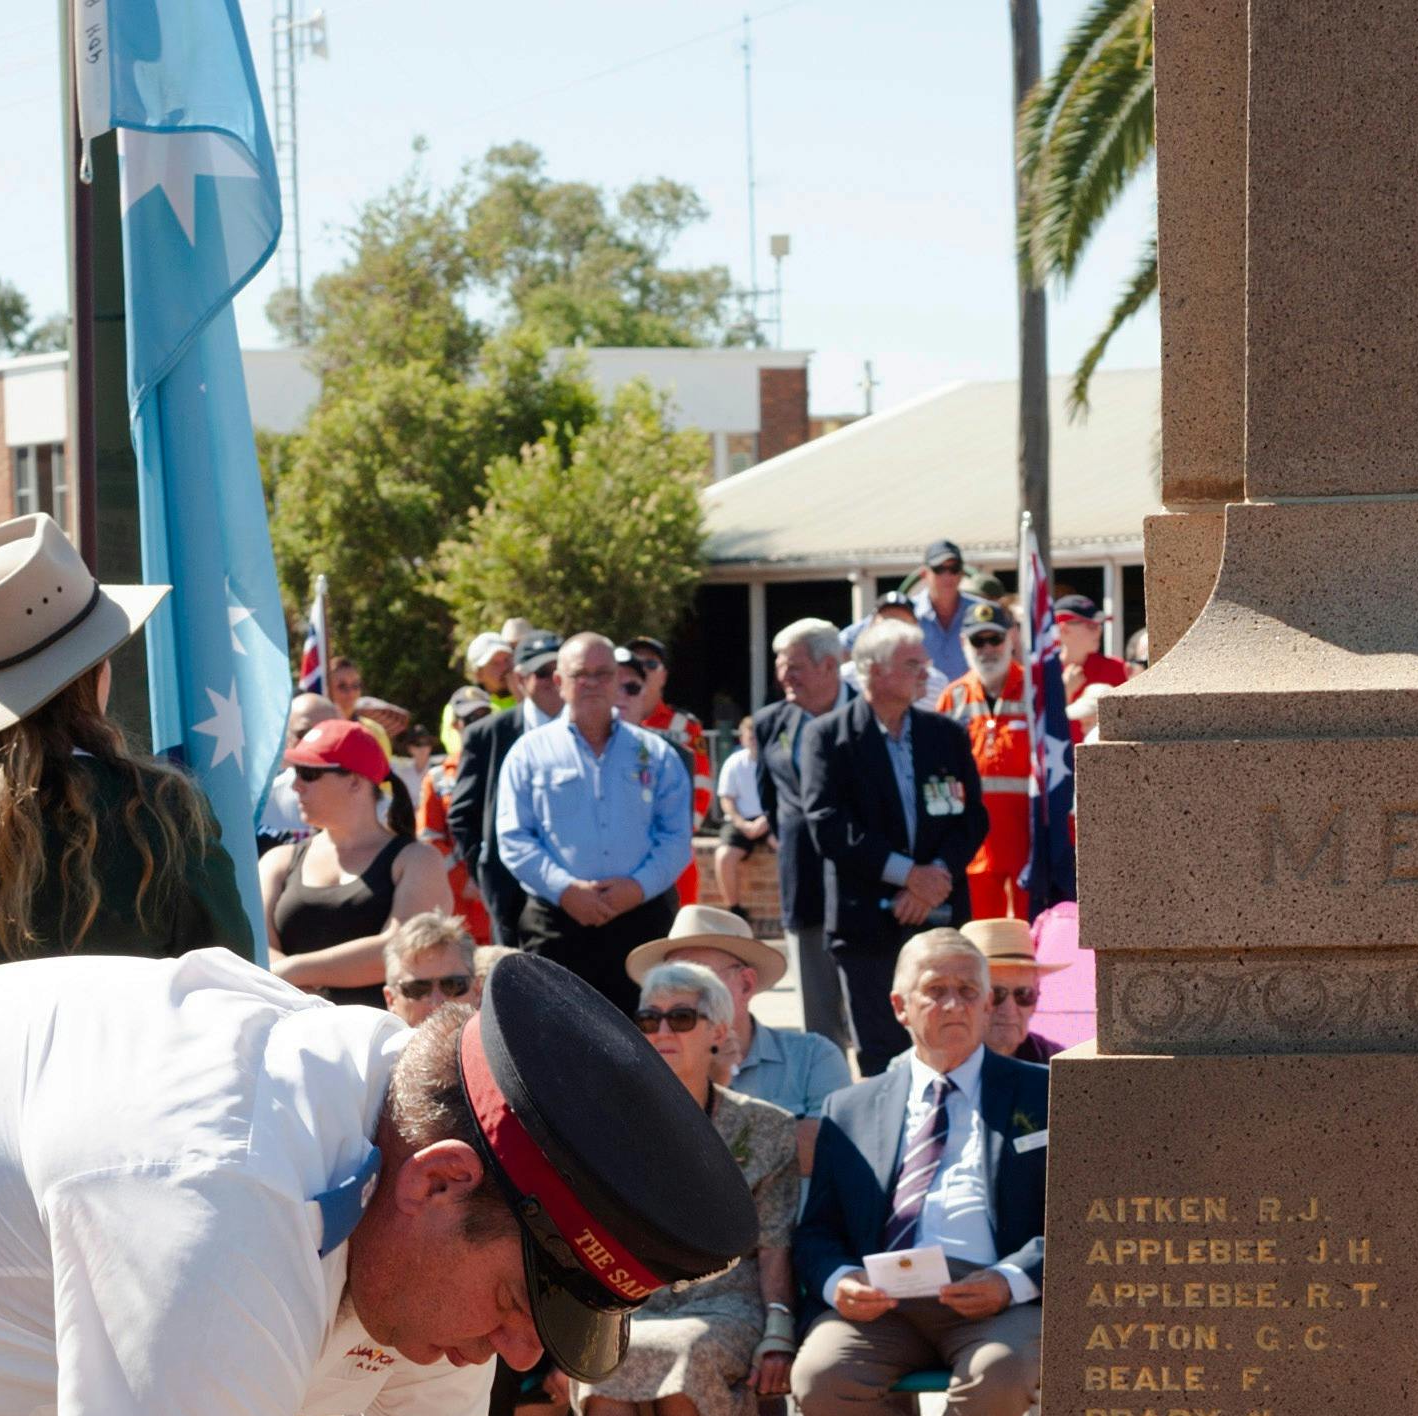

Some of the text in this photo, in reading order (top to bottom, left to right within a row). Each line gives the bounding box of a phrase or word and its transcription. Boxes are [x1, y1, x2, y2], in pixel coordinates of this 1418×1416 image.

[1085, 1196, 1237, 1223] AITKEN.
[574, 1228, 615, 1270] THE
[1086, 1239, 1286, 1265] APPLEBEE.
[1085, 1281, 1289, 1308] APPLEBEE.
[1085, 1325, 1233, 1351] AYTON.
[1084, 1366, 1271, 1392] BEALE. F.
